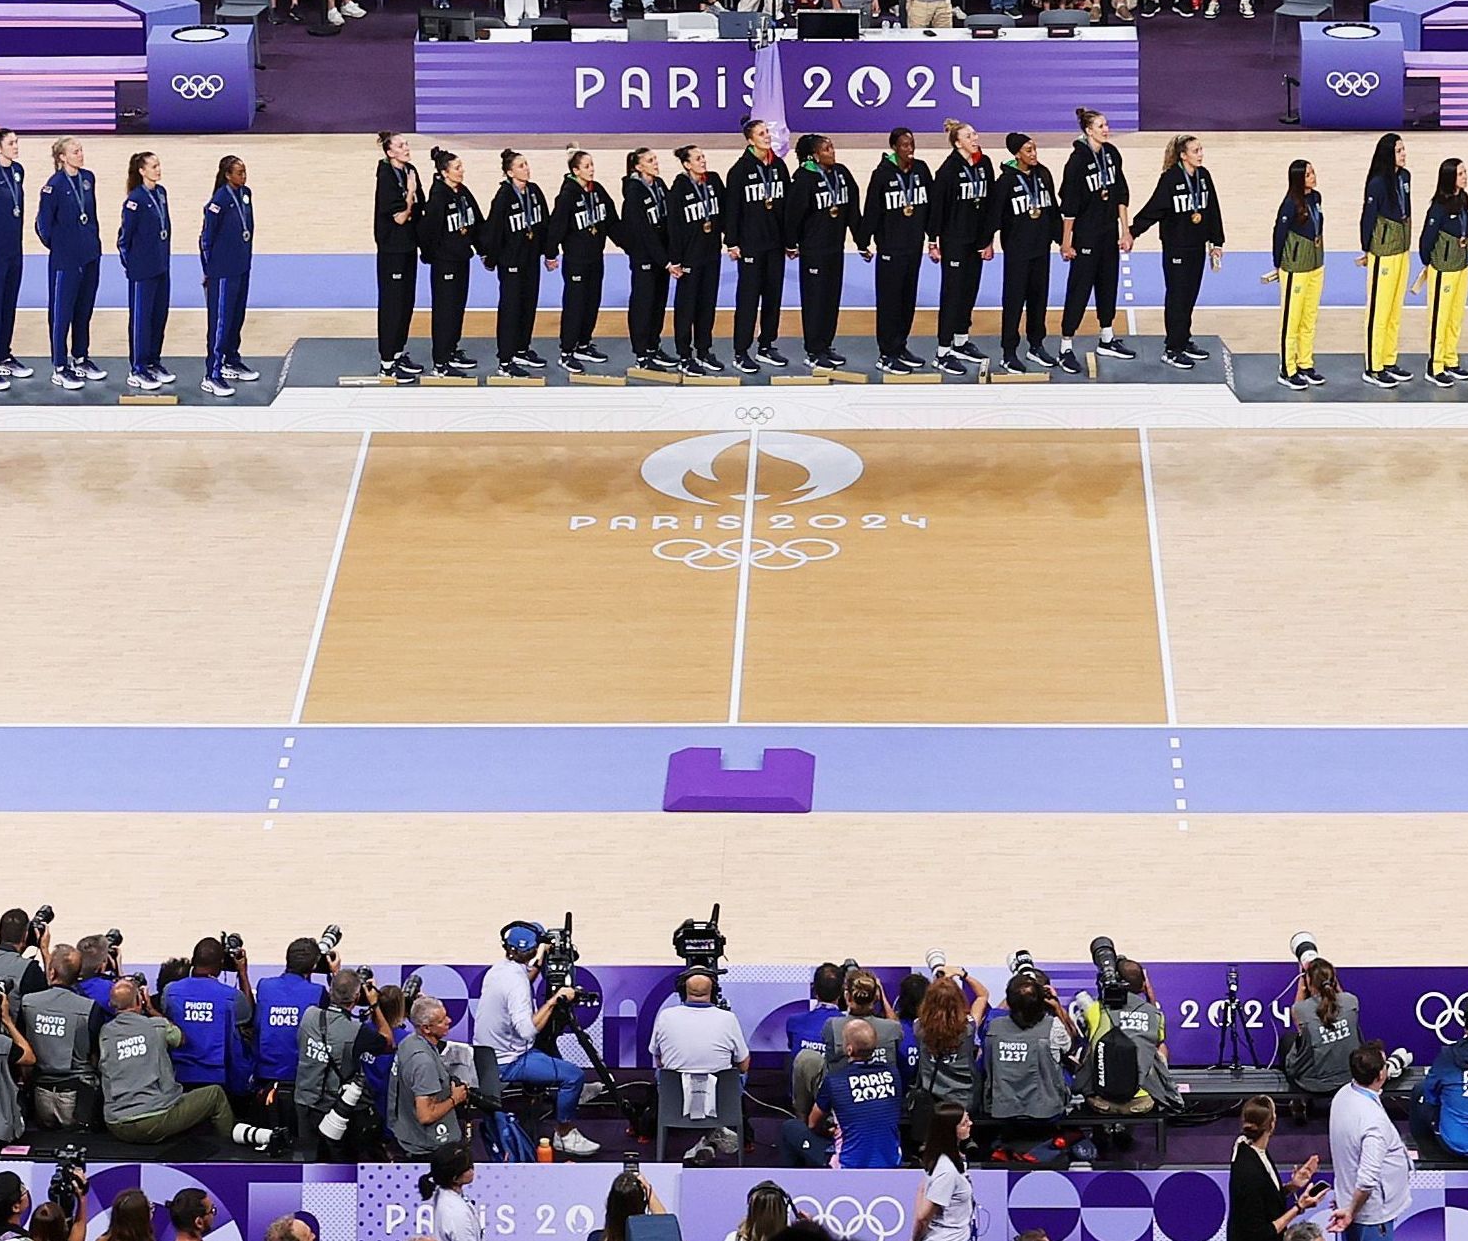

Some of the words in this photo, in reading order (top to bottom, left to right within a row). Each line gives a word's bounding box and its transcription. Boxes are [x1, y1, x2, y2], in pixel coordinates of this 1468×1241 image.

[802, 65, 981, 109] 2024
[744, 180, 784, 203] ITAIA
[957, 179, 988, 200] TAI
[684, 196, 719, 224] ITAI
[1011, 189, 1052, 216] ITAIA
[1172, 190, 1209, 213] ITAI
[447, 206, 475, 233] ITAIA
[508, 203, 542, 233] ITAI
[574, 203, 607, 232] ITAIA
[568, 514, 742, 531] PARIS
[768, 513, 928, 530] 2024
[185, 1002, 214, 1011] PHOTO
[269, 1007, 299, 1016] PHOTO
[35, 1015, 66, 1025] PHOTO
[184, 1010, 214, 1022] 1052
[269, 1015, 299, 1027] 0043
[1119, 1012, 1149, 1021] PHOTO
[35, 1023, 65, 1036] 3016
[1119, 1019, 1149, 1032] 1236
[1319, 1019, 1348, 1034] PTO
[117, 1036, 146, 1050] PHOTO
[1320, 1027, 1351, 1045] 1312
[118, 1046, 147, 1061] 2909
[307, 1037, 332, 1054] PHOO
[999, 1043, 1028, 1051] PHOTO
[999, 1050, 1028, 1062] 1237
[848, 1071, 894, 1090] PARIS
[851, 1084, 896, 1103] 2024
[385, 1204, 516, 1235] PAIS
[535, 1204, 596, 1235] 20
